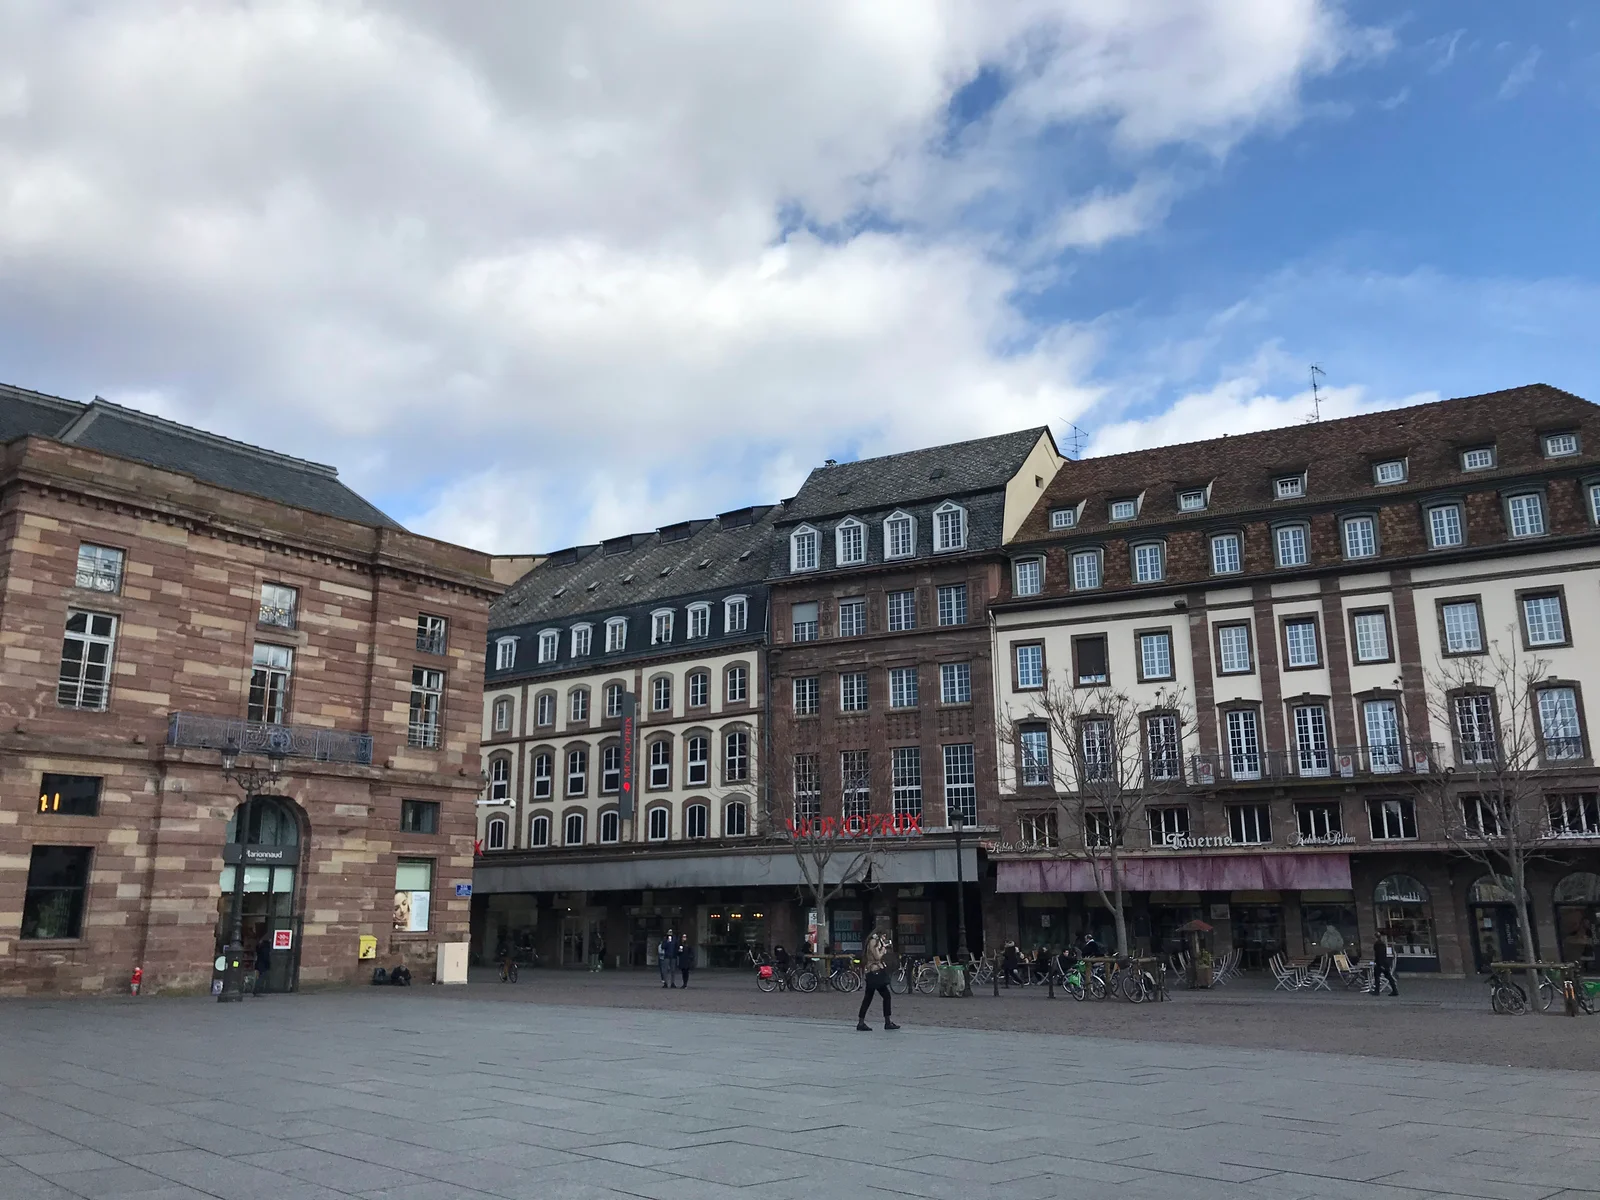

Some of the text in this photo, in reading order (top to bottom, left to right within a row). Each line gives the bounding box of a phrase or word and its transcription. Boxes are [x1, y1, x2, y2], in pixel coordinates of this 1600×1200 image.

[624, 716, 632, 779] MONOPRIX
[785, 812, 923, 839] MONOPRIX
[1166, 831, 1233, 850] Taverne
